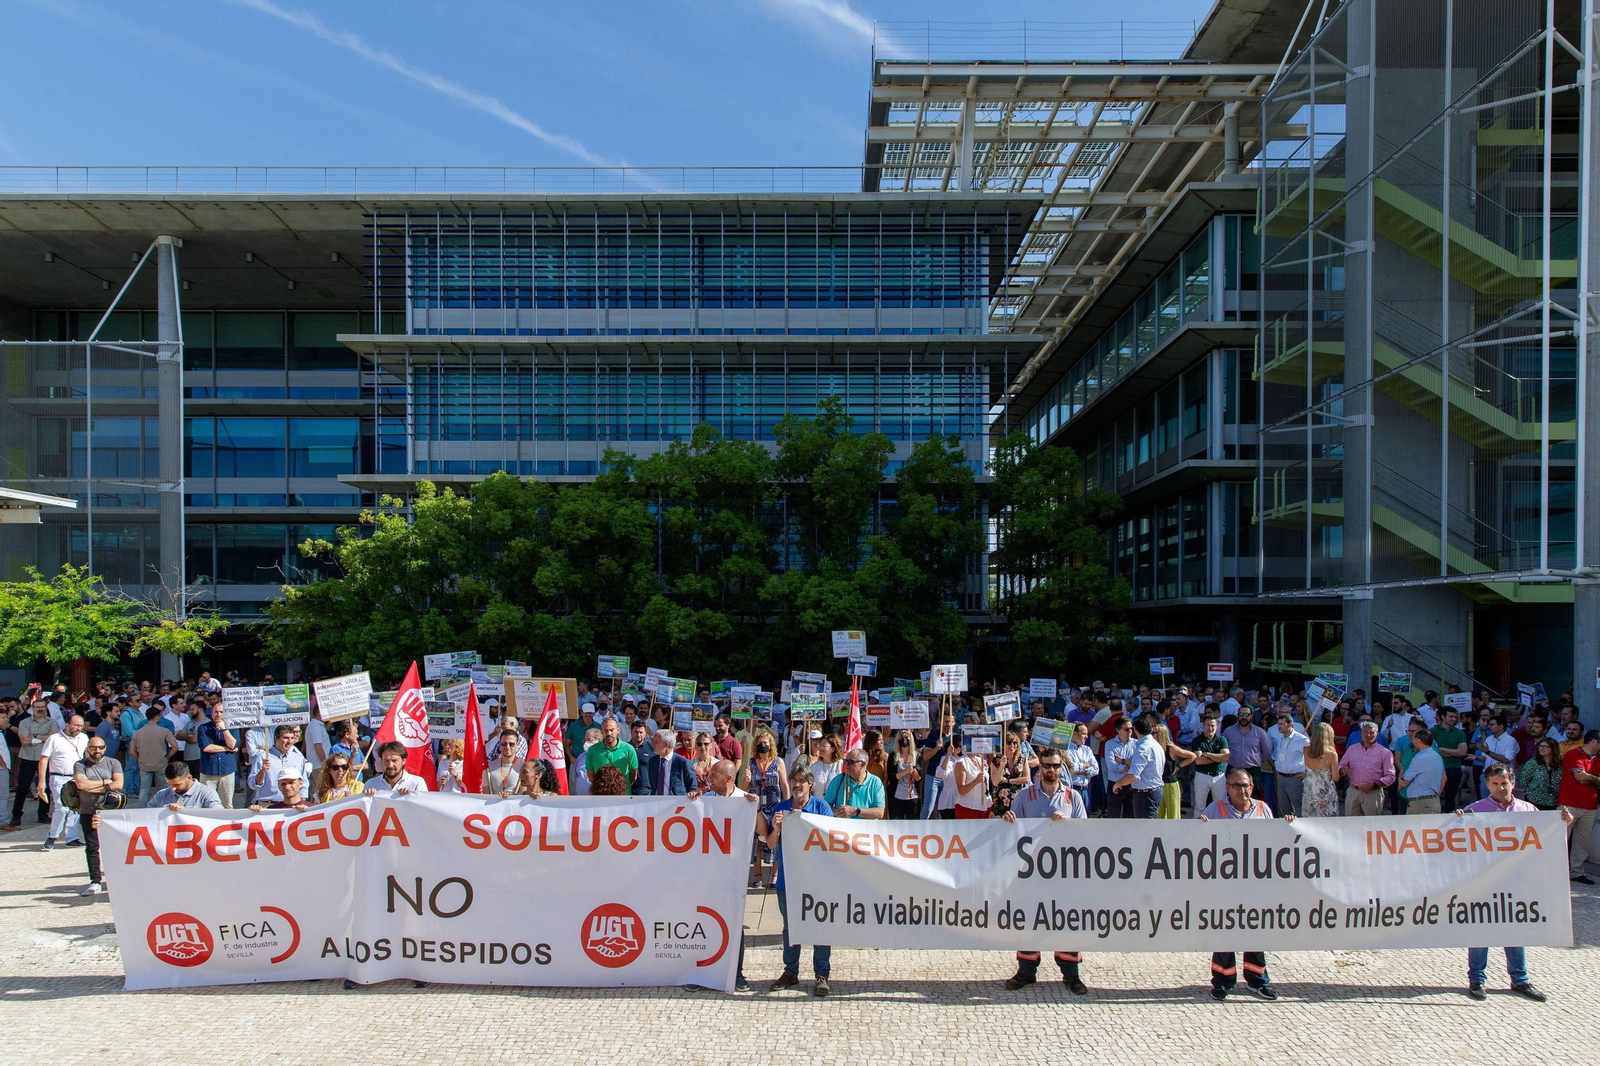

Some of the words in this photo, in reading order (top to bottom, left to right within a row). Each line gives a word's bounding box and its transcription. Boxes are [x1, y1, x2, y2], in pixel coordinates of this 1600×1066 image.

[316, 681, 343, 691] ABENGOA
[229, 719, 261, 727] ABENGOA
[125, 808, 410, 865] ABENGOA
[464, 806, 732, 856] SOLUCIÓN
[803, 828, 969, 860] ABENGOA
[1366, 826, 1542, 855] INABENSA
[1016, 836, 1133, 880] Somos
[1144, 833, 1331, 880] Andalucía.
[386, 874, 474, 919] NO
[801, 893, 839, 923] Por
[846, 893, 866, 925] la
[873, 894, 989, 929] viabilidad
[997, 899, 1026, 931] de
[1032, 899, 1141, 939] Abengoa
[1148, 908, 1163, 939] y
[1170, 900, 1190, 931] el
[1198, 903, 1301, 931] sustento
[1308, 899, 1338, 929] de
[1345, 896, 1406, 928] miles
[1412, 896, 1440, 926] de
[1446, 892, 1547, 925] familias.
[155, 922, 200, 945] UGT
[218, 920, 277, 941] FICA
[589, 915, 635, 941] UGT
[653, 921, 707, 940] FICA
[226, 951, 255, 959] SEVILLA
[244, 939, 278, 949] Industria
[321, 937, 341, 958] A
[345, 937, 392, 964] LOS
[402, 938, 552, 966] DESPIDOS
[654, 942, 661, 950] F.
[662, 942, 673, 950] de
[674, 942, 707, 950] Industria
